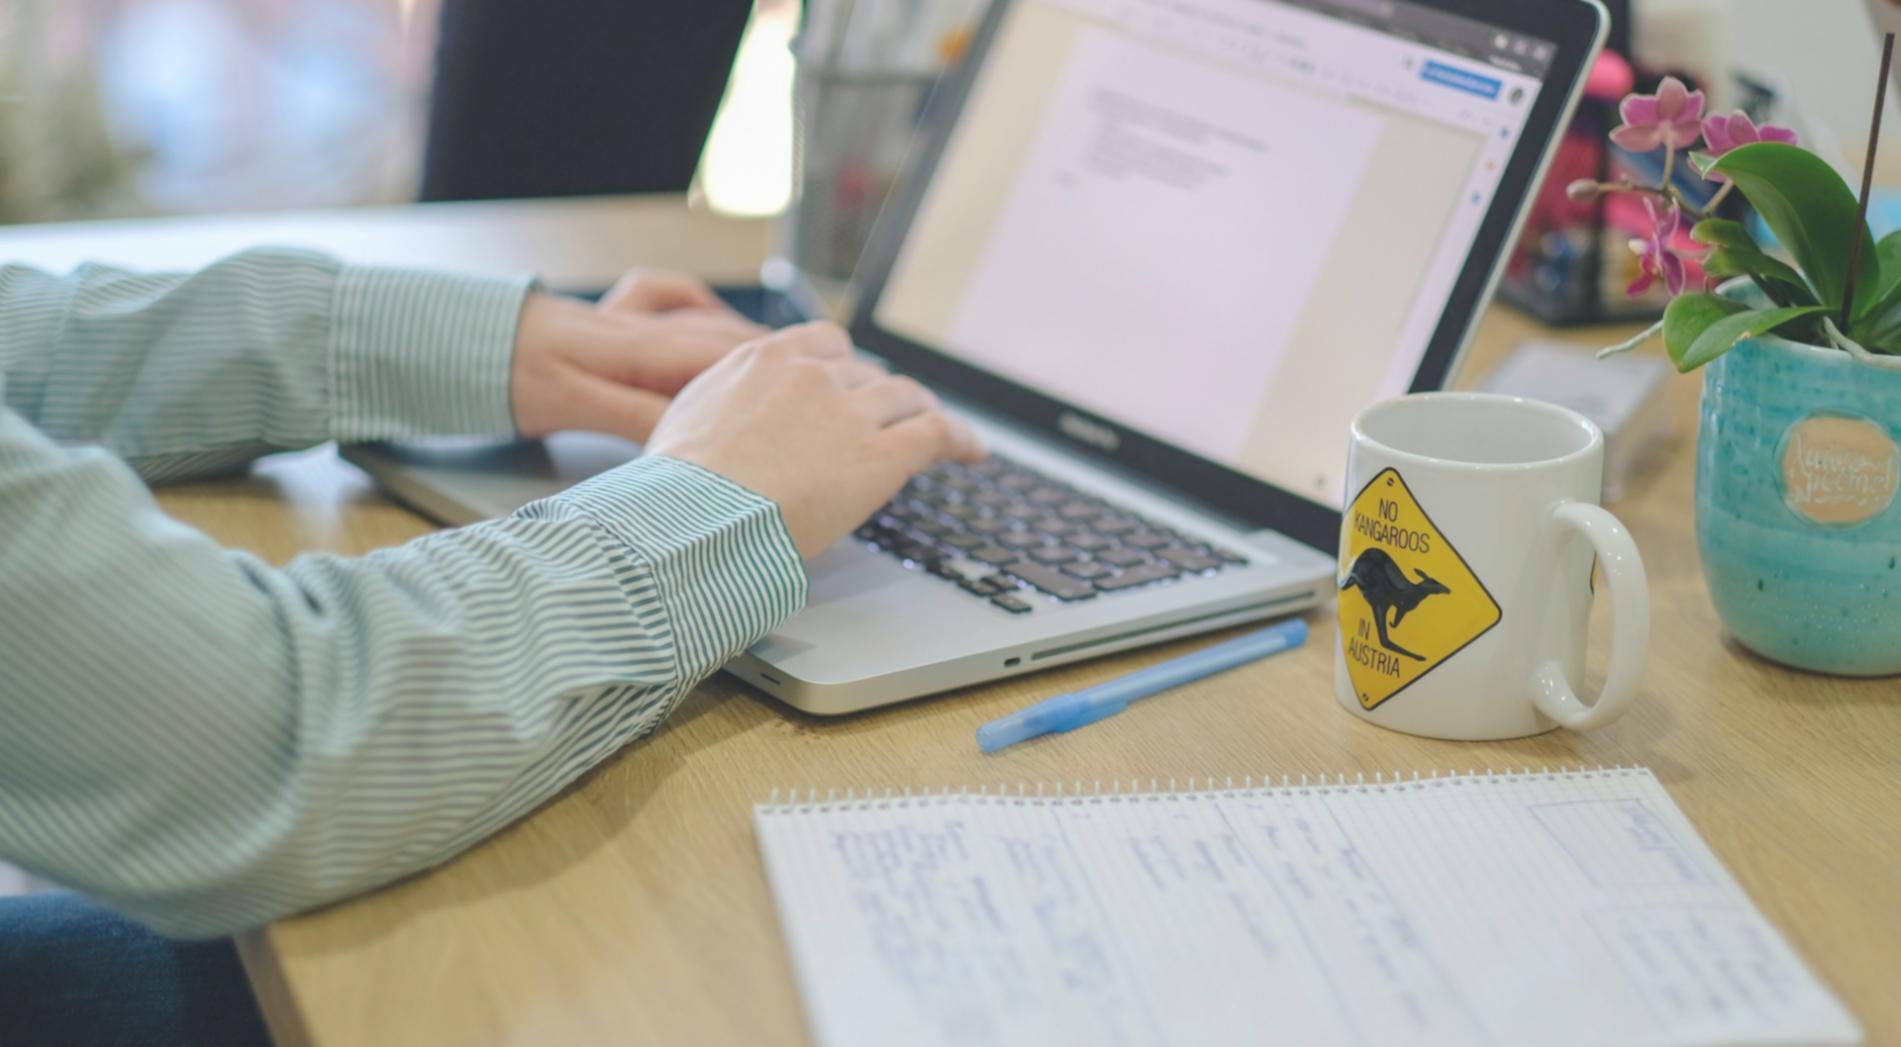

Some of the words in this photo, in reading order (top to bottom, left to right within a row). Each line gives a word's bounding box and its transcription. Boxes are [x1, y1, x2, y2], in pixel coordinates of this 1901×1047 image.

[1379, 498, 1398, 522] NO
[1355, 513, 1430, 553] KANGAROOS
[1358, 618, 1370, 640] IN
[1348, 637, 1400, 678] AUSTRIA
